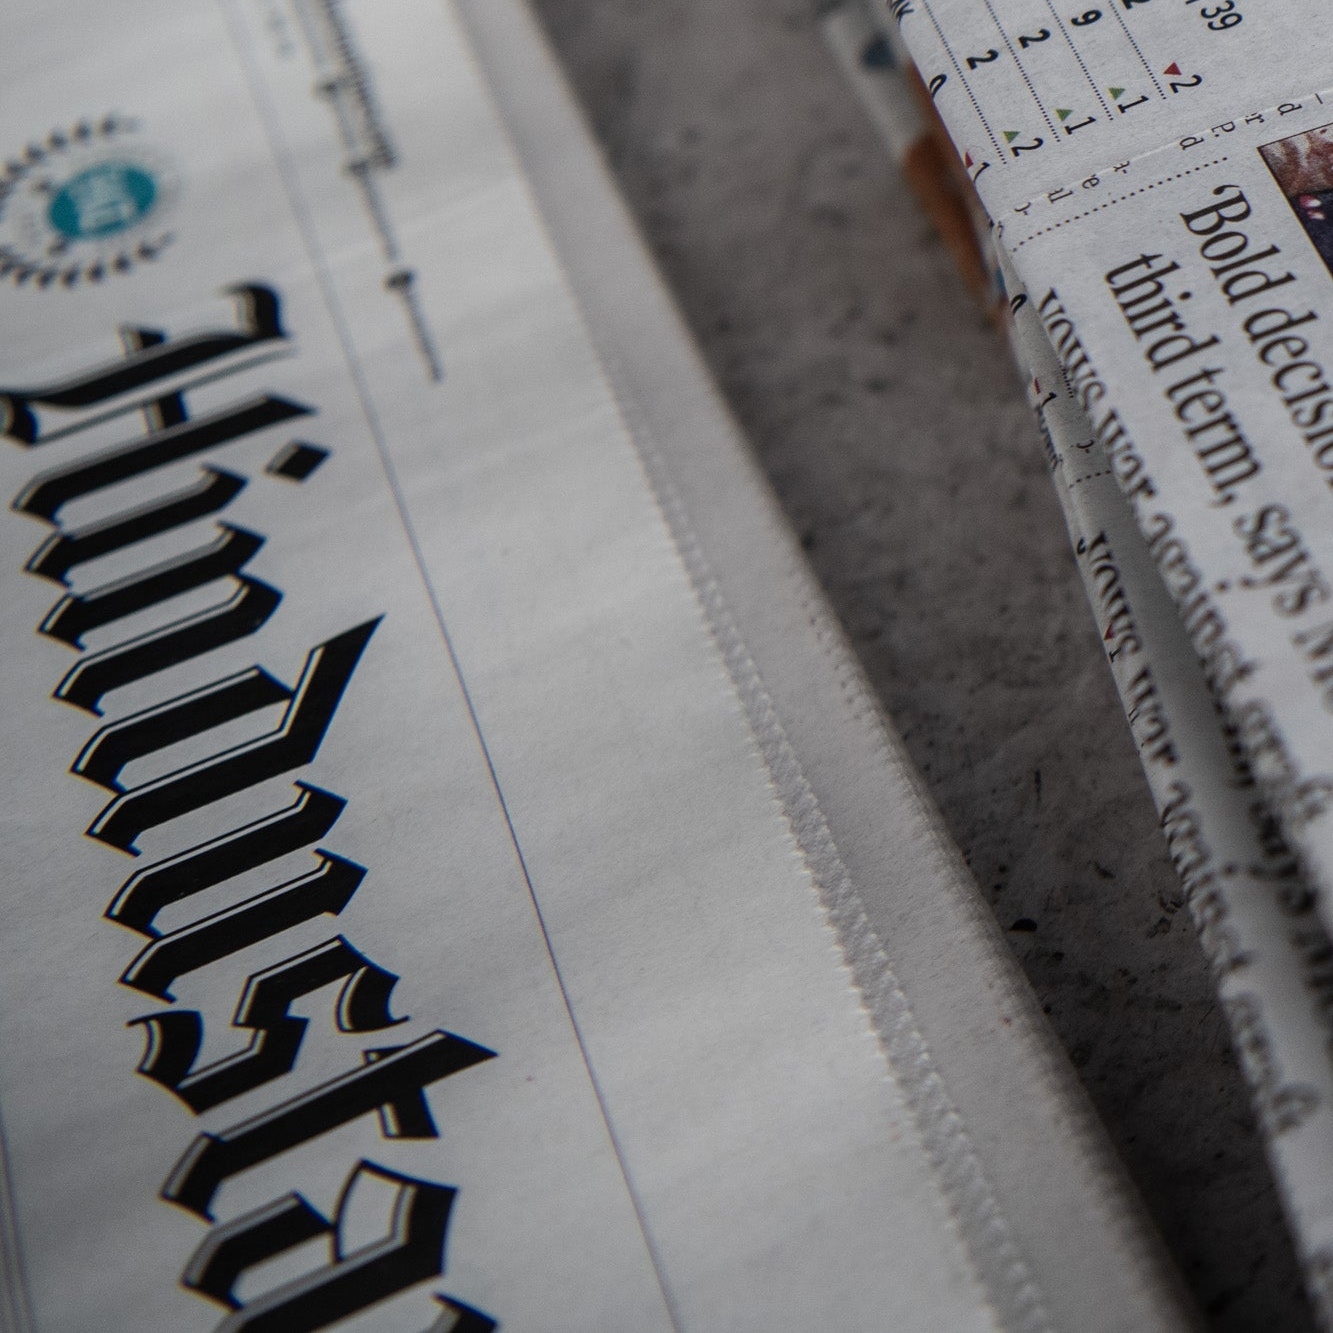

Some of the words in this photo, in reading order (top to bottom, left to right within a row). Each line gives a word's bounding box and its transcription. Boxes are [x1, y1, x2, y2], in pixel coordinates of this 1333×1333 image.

[1199, 0, 1242, 31] 39
[1168, 74, 1202, 94] 2
[1103, 254, 1219, 373] third
[1164, 368, 1261, 507] term,
[1233, 504, 1327, 617] says
